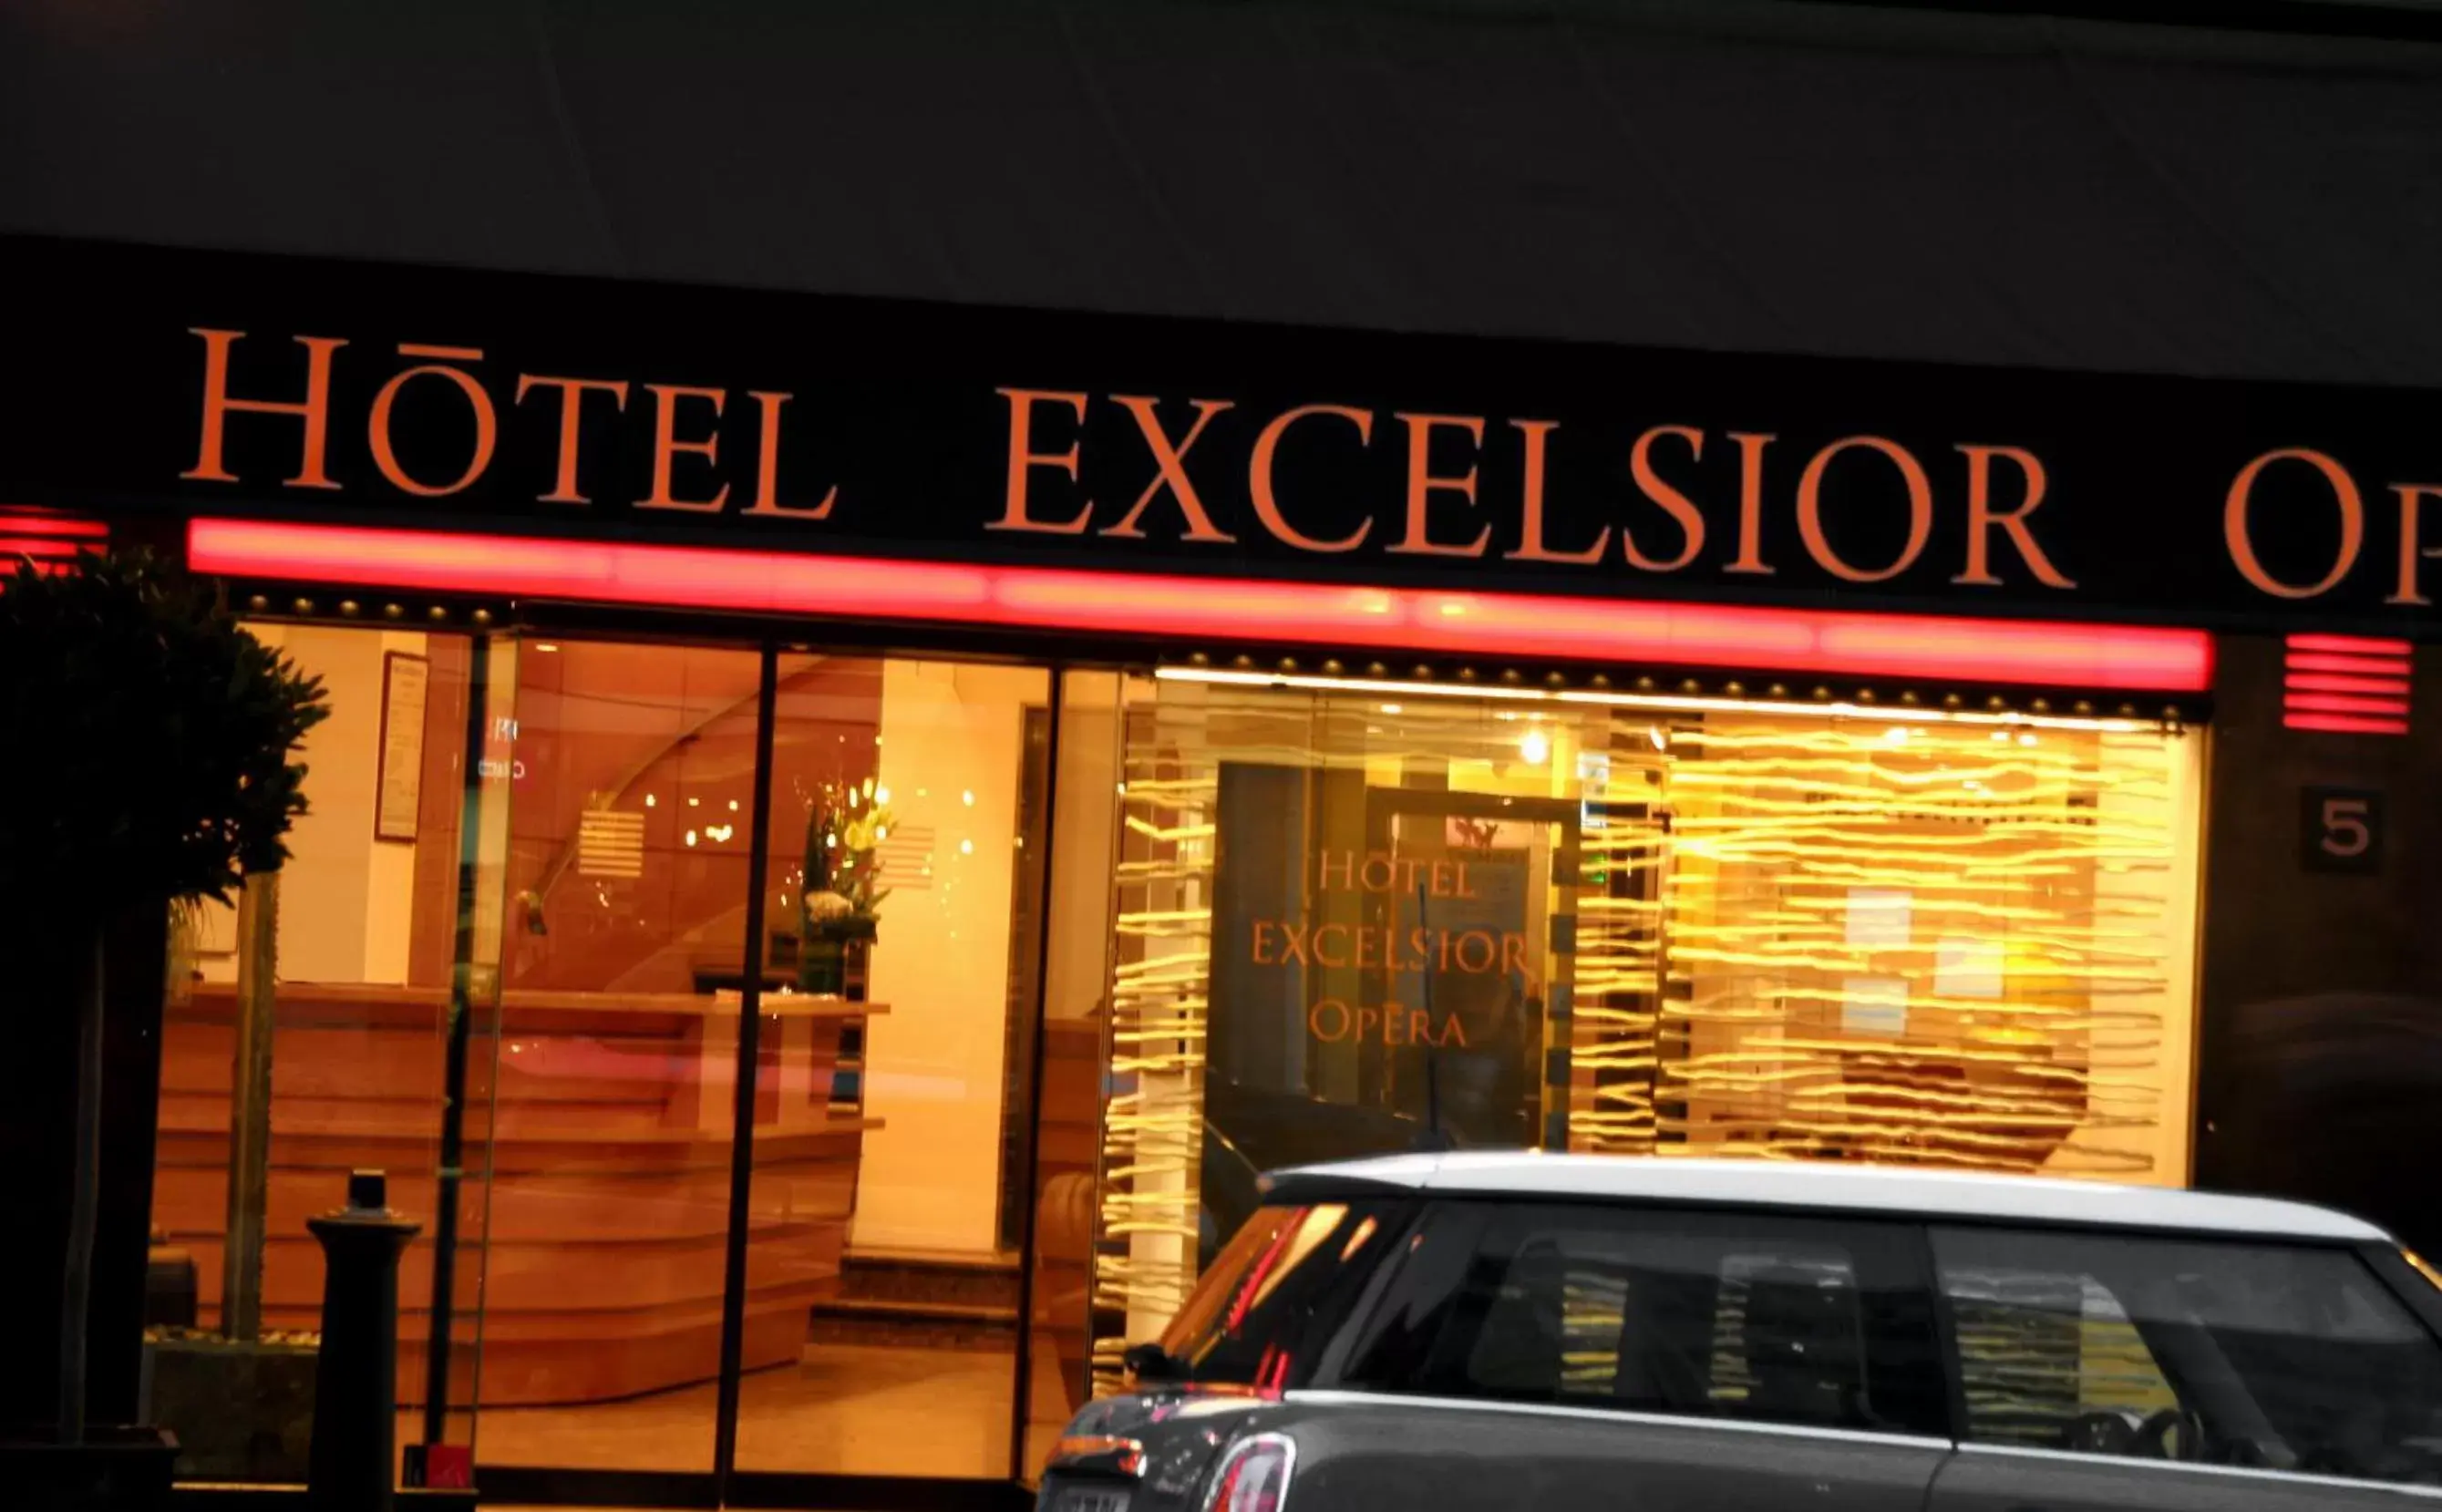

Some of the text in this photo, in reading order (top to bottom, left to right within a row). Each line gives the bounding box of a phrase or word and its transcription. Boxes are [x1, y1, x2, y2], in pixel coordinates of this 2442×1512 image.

[984, 386, 2077, 589] EXCELSIOR
[2320, 798, 2370, 857] 5
[1252, 921, 1536, 978] EXCELSIOR
